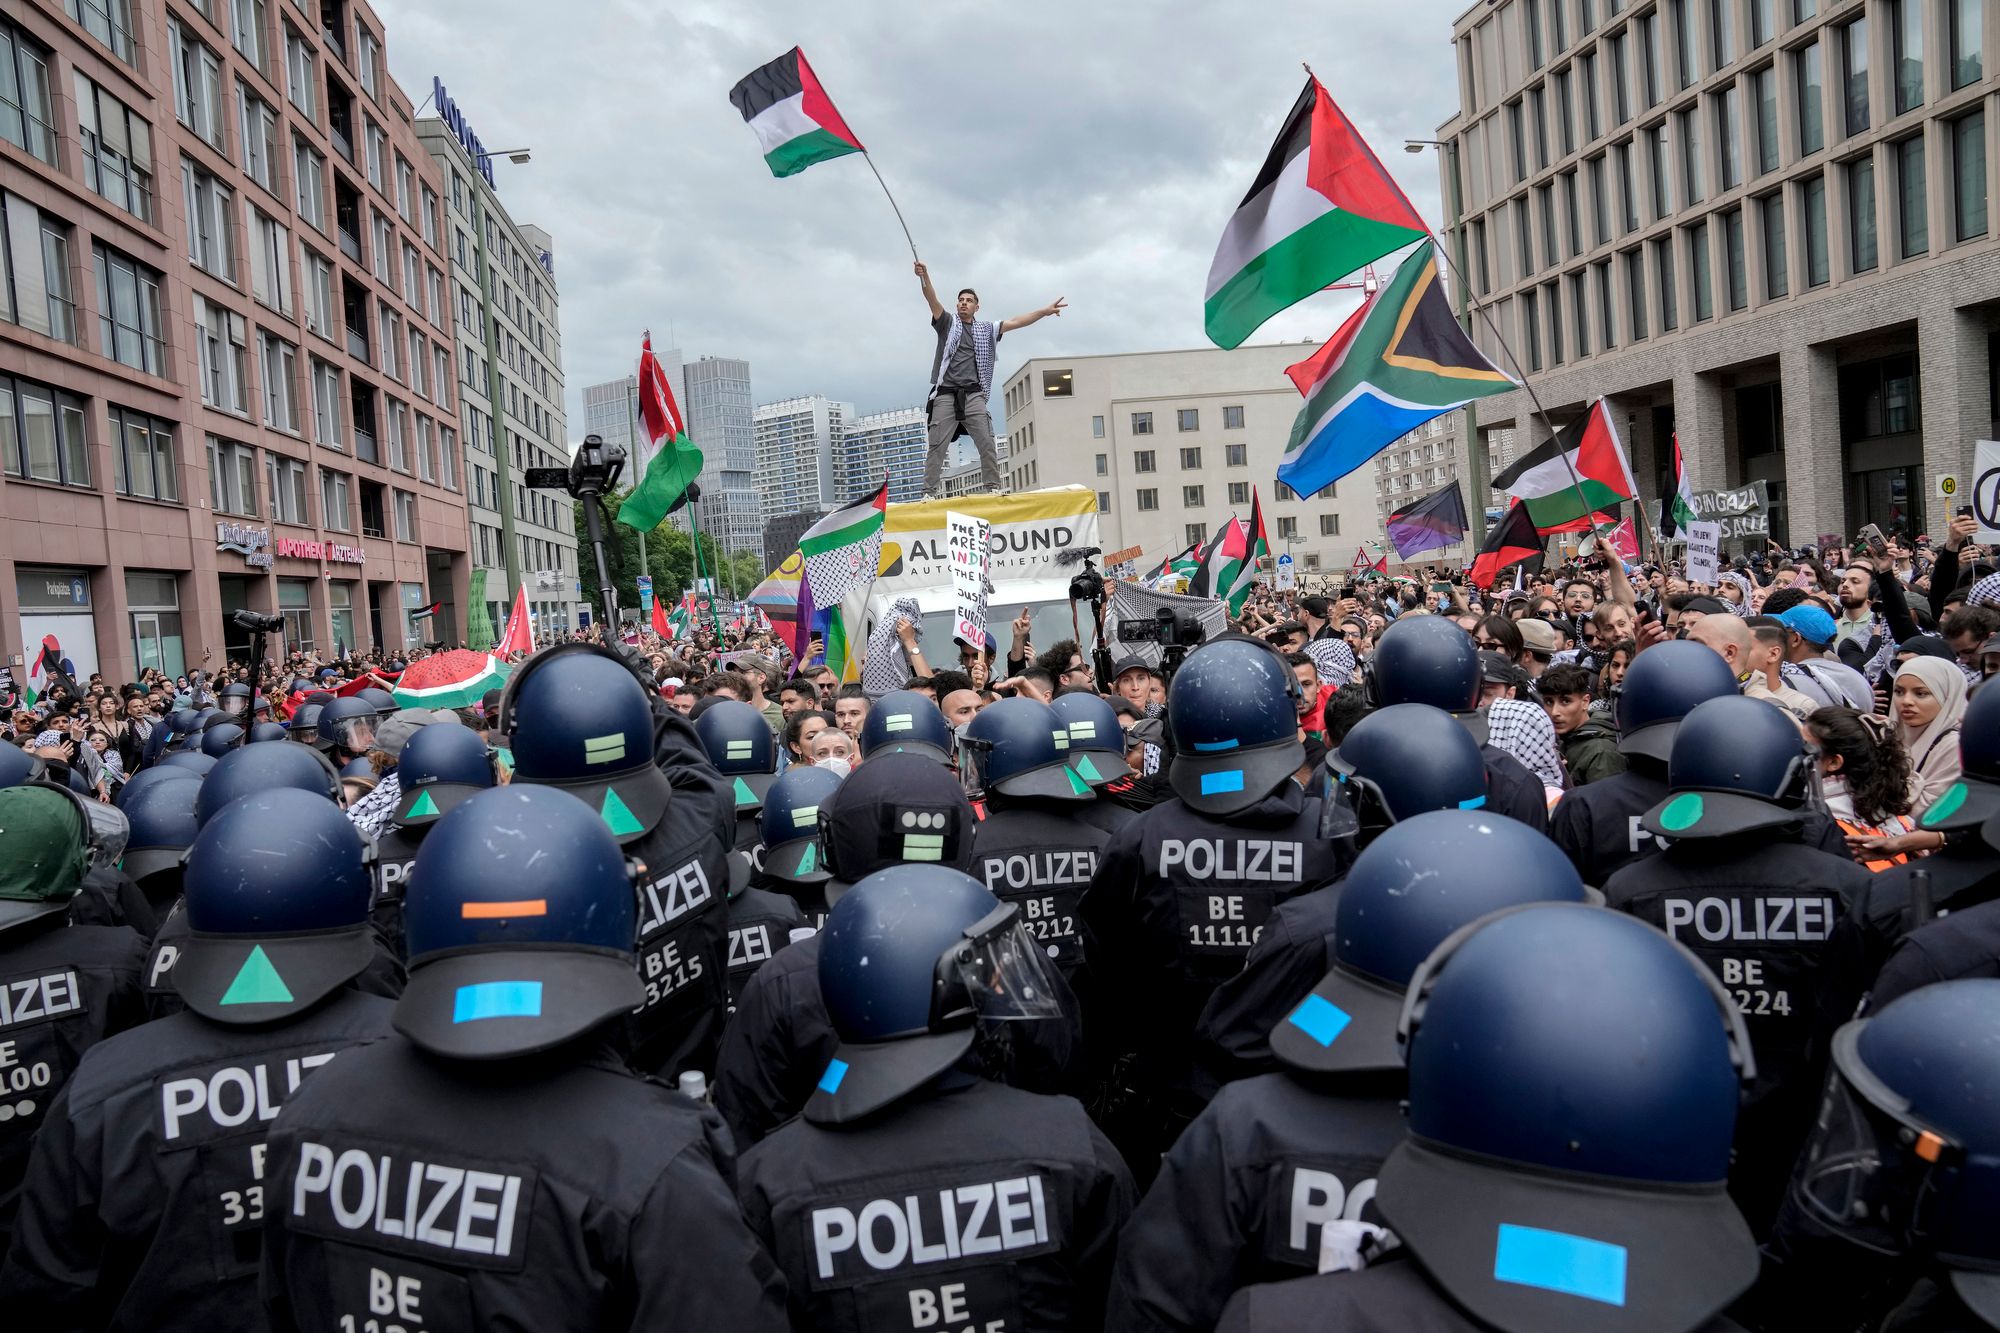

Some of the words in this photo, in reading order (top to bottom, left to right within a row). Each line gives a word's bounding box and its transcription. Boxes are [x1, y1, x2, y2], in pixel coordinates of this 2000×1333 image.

[1716, 488, 1760, 512] GAZA
[909, 526, 1073, 562] ALOUND
[950, 536, 976, 550] ARE
[952, 523, 975, 537] THE
[1734, 515, 1769, 538] ALLE
[955, 568, 975, 581] THE
[984, 851, 1101, 891] POLIZEI
[1159, 838, 1303, 882] POLIZEI
[641, 859, 711, 935] IZEI
[1026, 896, 1056, 919] BE
[1208, 896, 1244, 920] BE
[1664, 897, 1834, 941] POLIZEI
[645, 940, 681, 979] BE
[1722, 958, 1764, 985] BE
[0, 971, 81, 1026] IZEI
[633, 955, 703, 1014] 3215
[293, 1142, 521, 1256] POLIZEI
[812, 1175, 1049, 1279] POLIZEI
[370, 1268, 423, 1323] BE
[908, 1283, 970, 1328] BE
